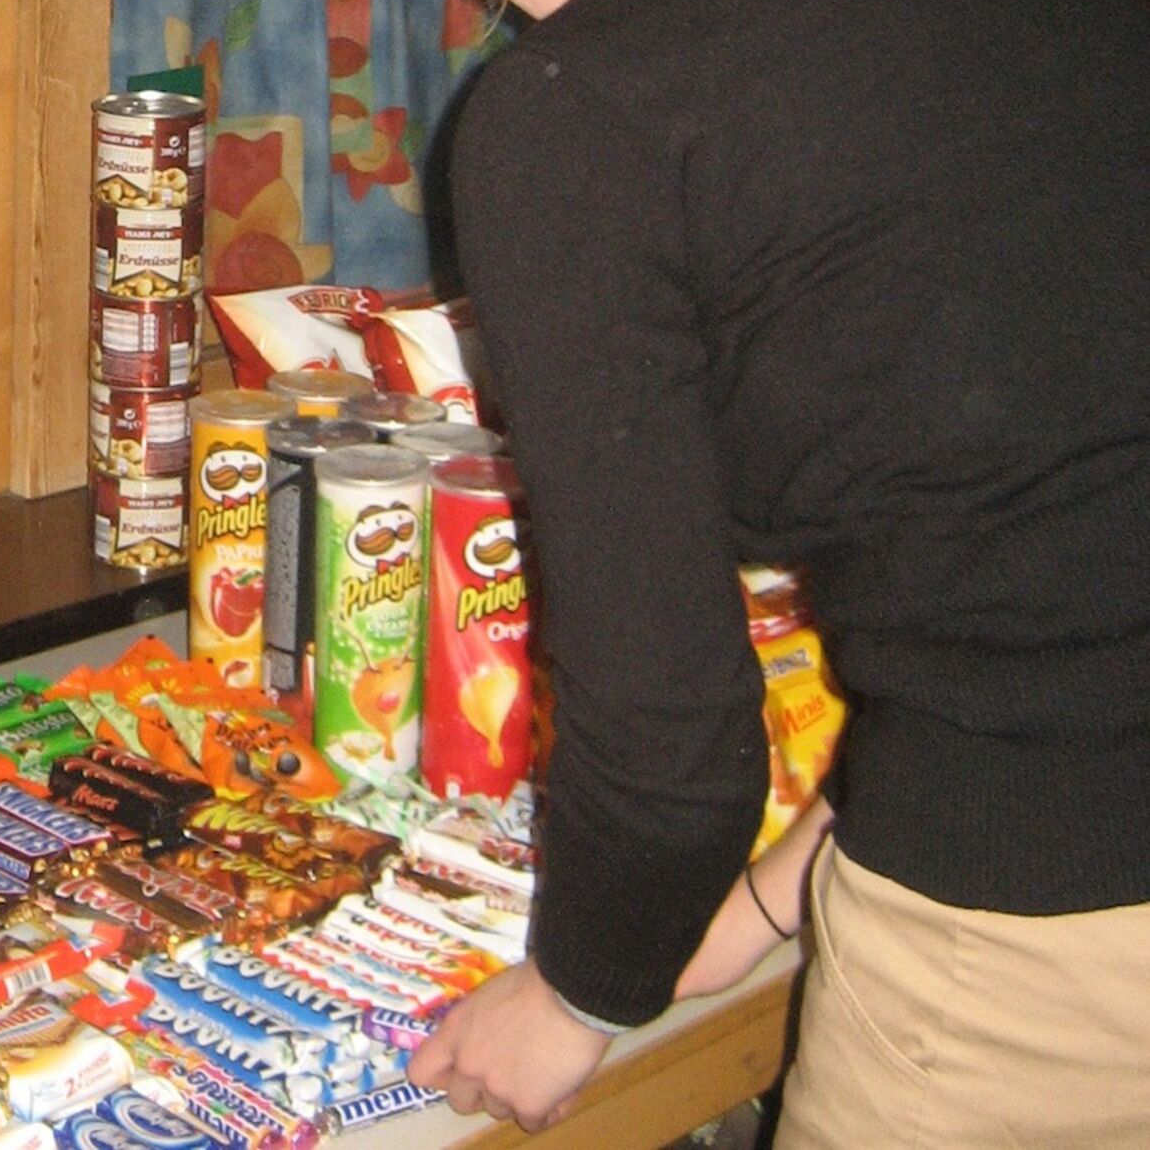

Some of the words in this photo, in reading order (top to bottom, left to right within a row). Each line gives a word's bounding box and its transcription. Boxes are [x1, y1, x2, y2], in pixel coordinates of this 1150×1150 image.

[119, 253, 179, 267] Erdnüsse
[198, 497, 267, 547] Pringle
[154, 961, 297, 1056] BOUNTY
[212, 945, 362, 1030] BOUNTY
[148, 1003, 287, 1082] BOUNTY
